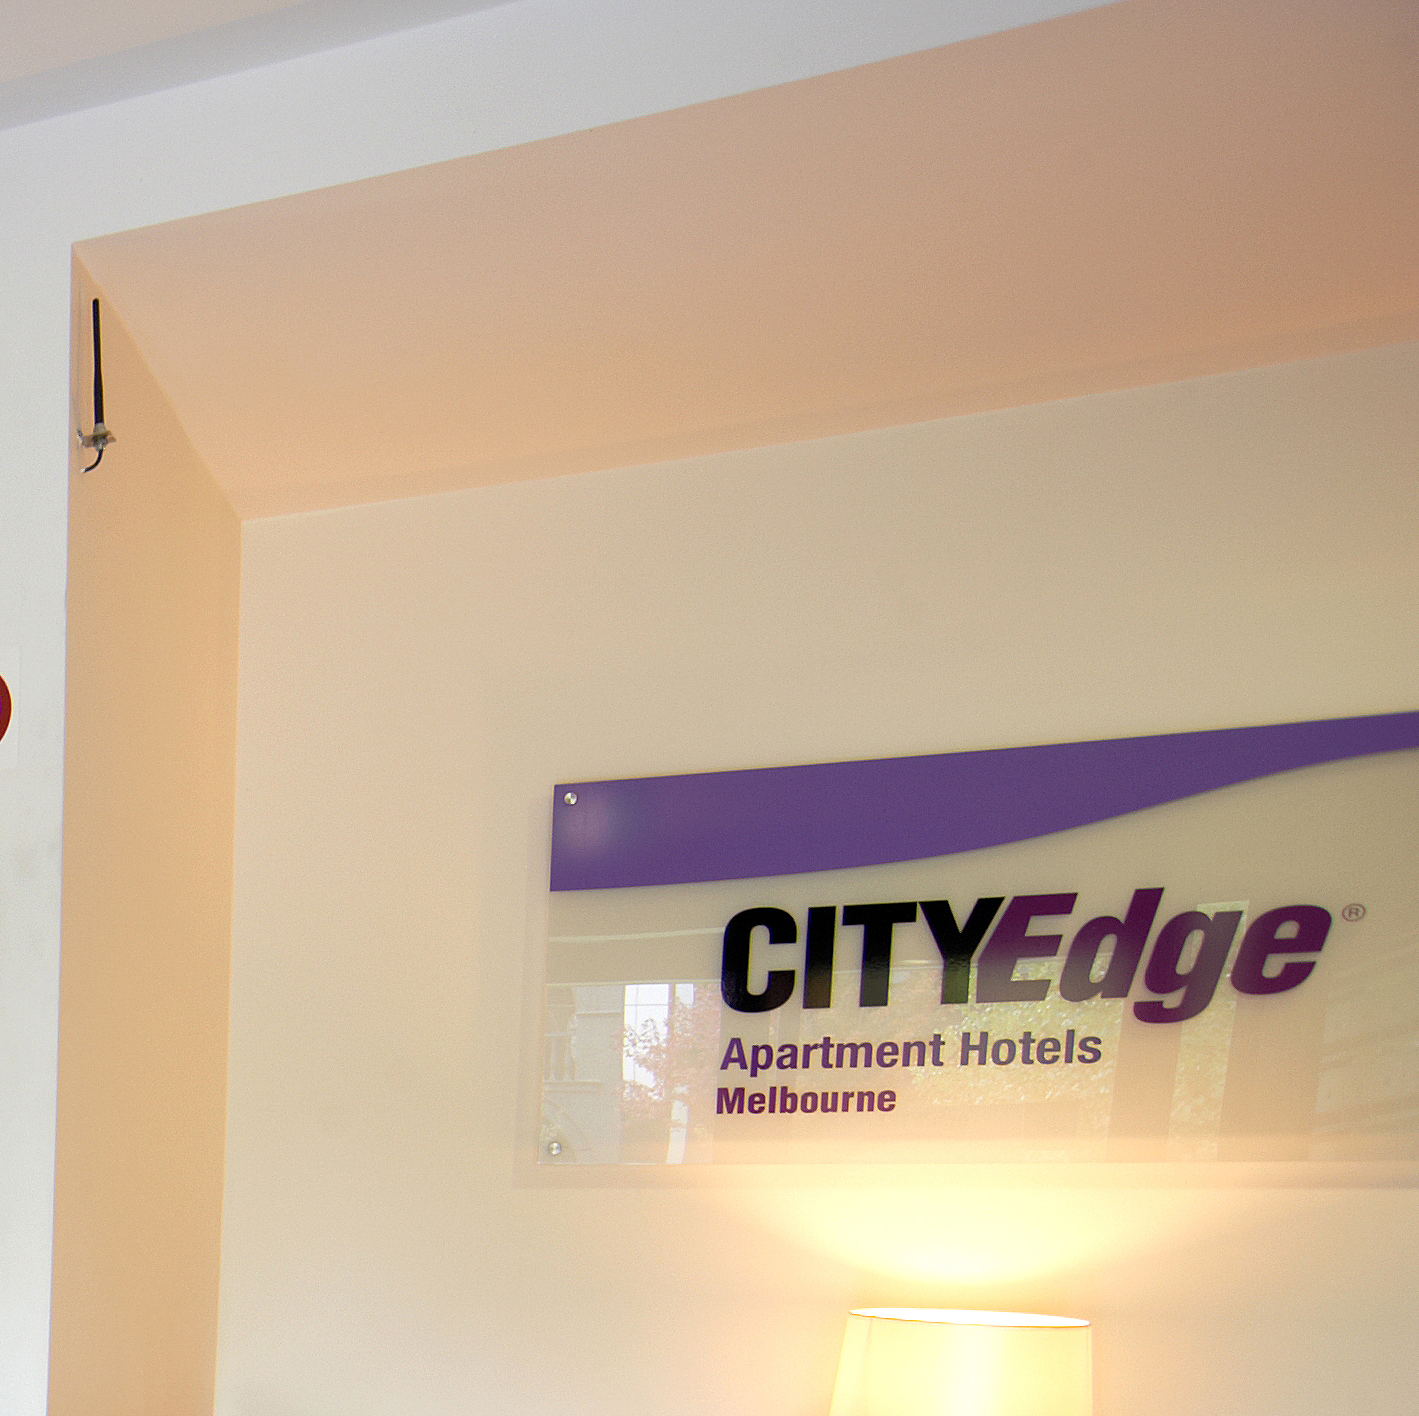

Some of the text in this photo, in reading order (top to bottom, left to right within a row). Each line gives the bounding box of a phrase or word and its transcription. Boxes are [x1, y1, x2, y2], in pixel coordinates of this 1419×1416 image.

[720, 1028, 1102, 1078] Apartment Hotels
[716, 1084, 897, 1117] Melbourne
